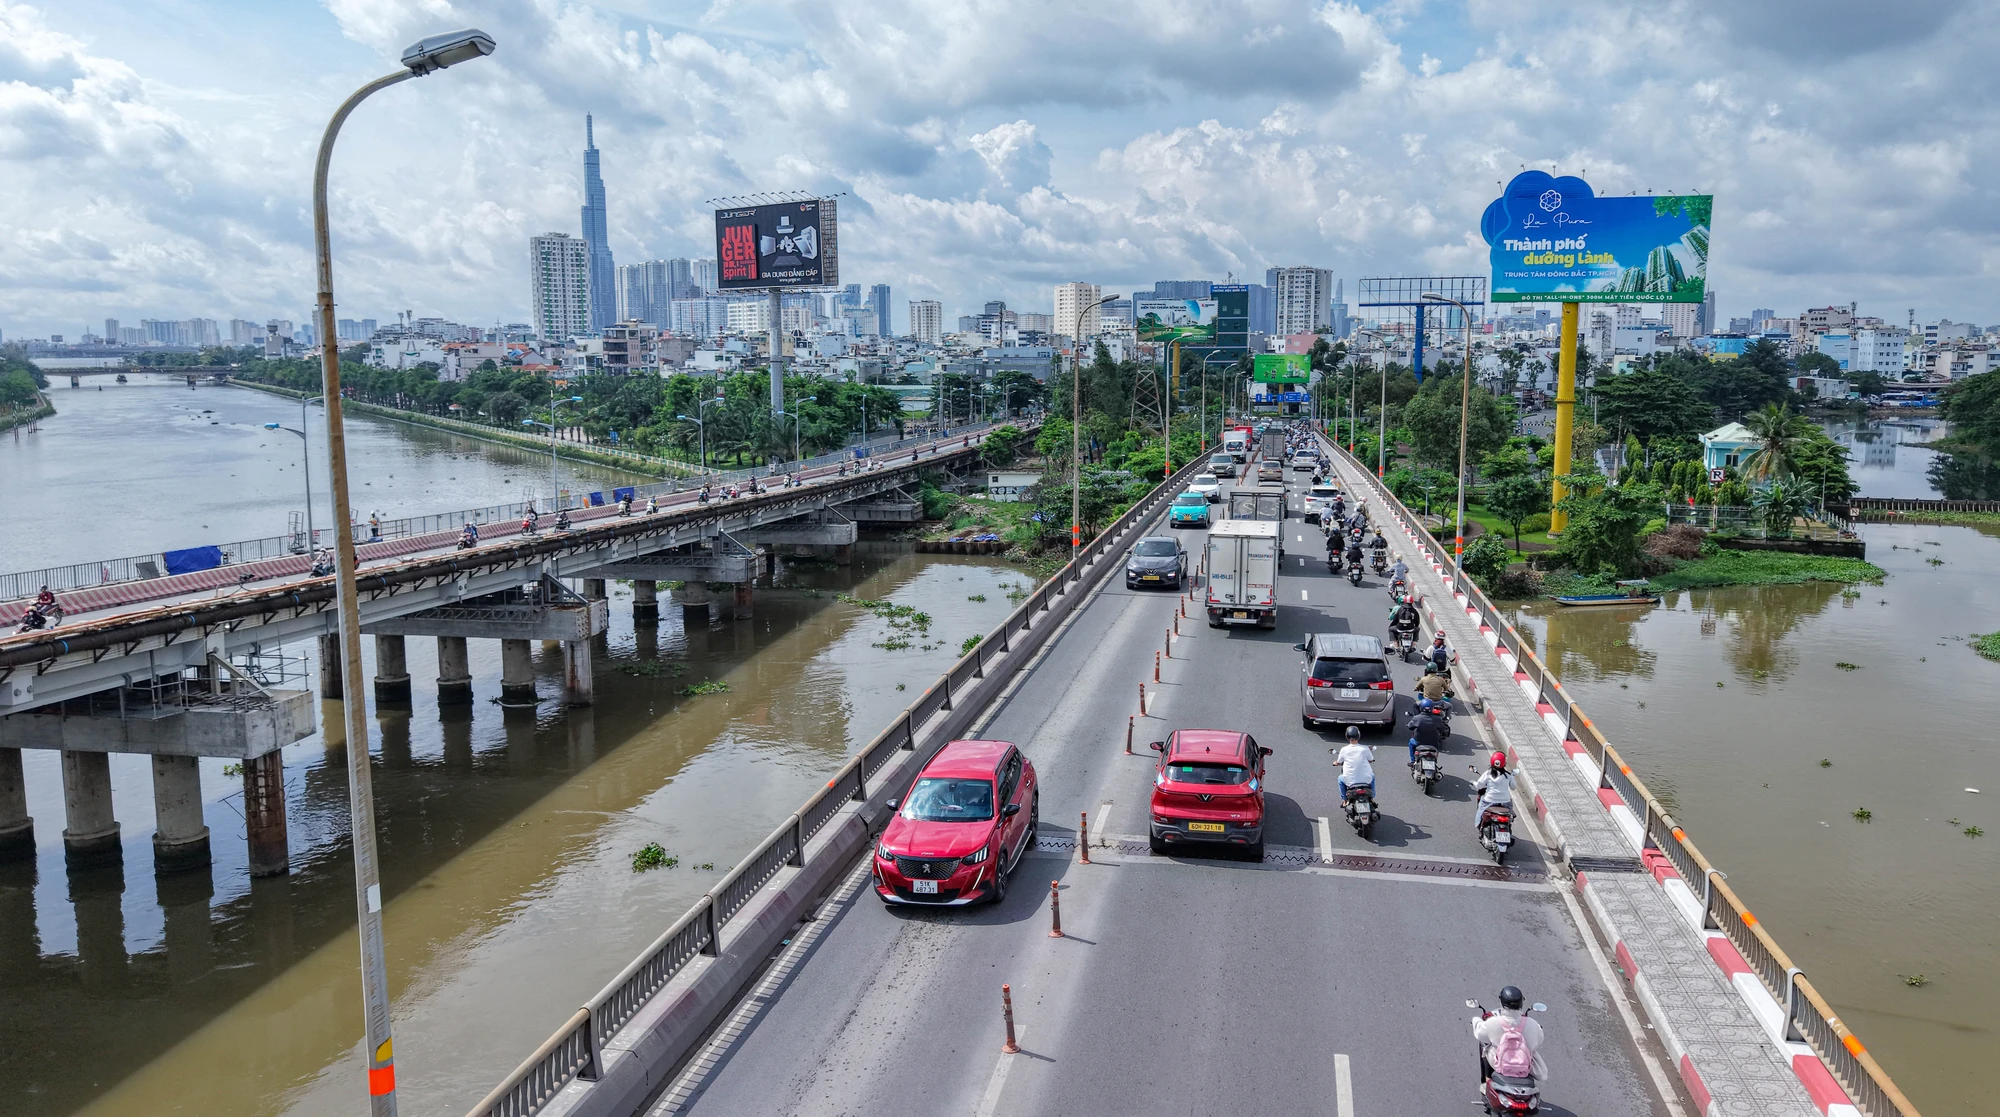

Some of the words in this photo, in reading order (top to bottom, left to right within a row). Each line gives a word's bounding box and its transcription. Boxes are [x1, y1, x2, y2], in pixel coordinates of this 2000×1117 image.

[1553, 212, 1593, 228] Pura
[722, 224, 752, 244] JUN
[1504, 236, 1552, 251] Thành
[1554, 233, 1588, 252] phố
[722, 242, 756, 261] GER
[1524, 251, 1574, 268] dưỡng
[724, 266, 747, 279] spirit
